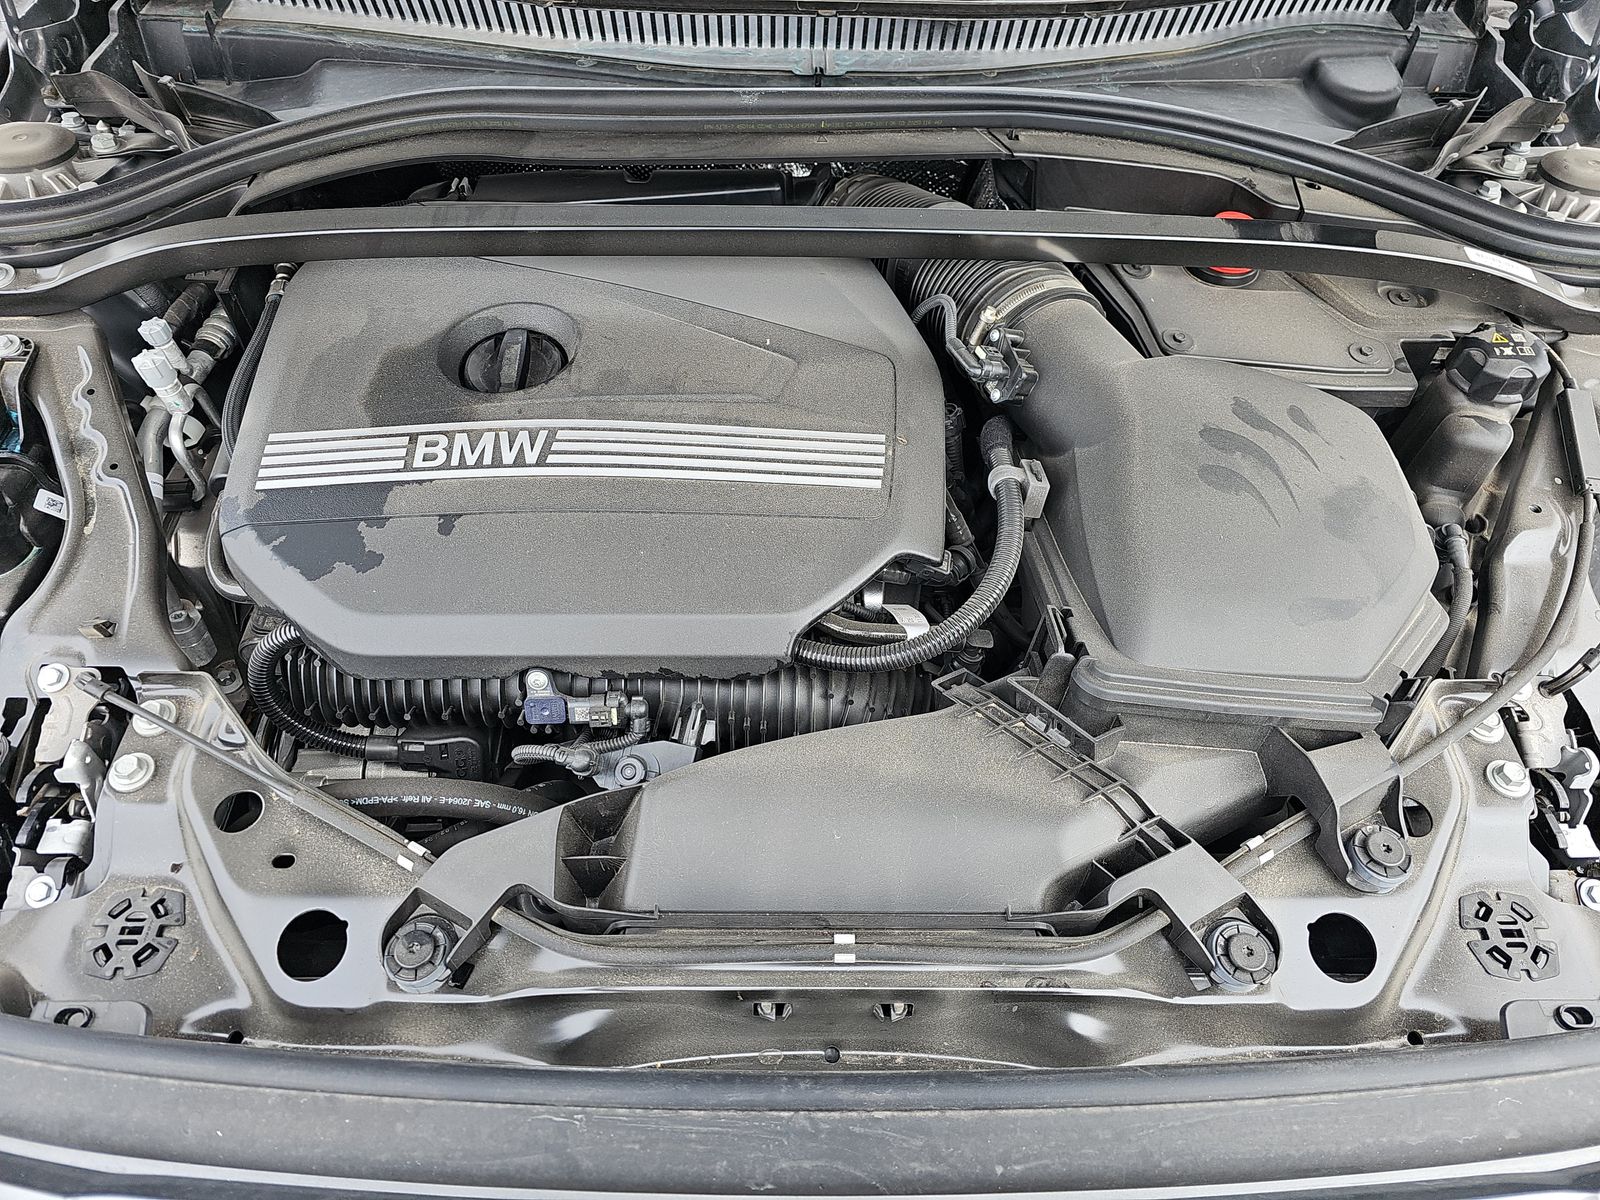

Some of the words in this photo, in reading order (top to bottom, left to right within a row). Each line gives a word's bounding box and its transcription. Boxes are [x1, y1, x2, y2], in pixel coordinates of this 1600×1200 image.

[412, 430, 549, 468] BMW
[400, 795, 420, 804] Refr.
[421, 795, 433, 804] All
[439, 796, 472, 806] J2064-E
[473, 799, 492, 809] SAE
[497, 802, 511, 811] mm
